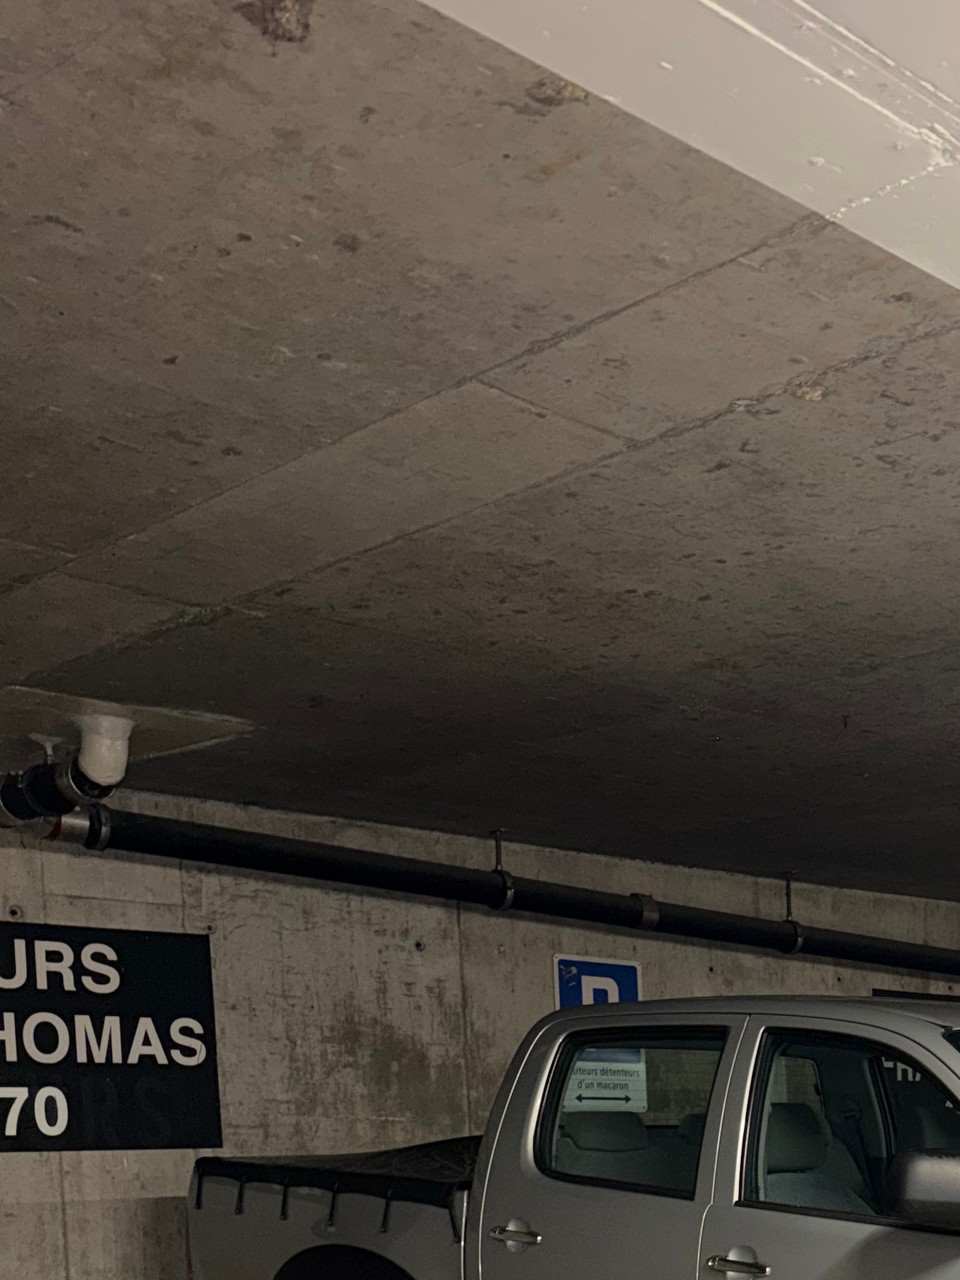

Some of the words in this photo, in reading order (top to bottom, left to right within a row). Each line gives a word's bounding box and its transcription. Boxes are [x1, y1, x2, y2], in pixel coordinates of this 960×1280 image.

[0, 938, 121, 994] URS
[596, 1081, 629, 1090] macaron
[0, 1086, 69, 1136] 70
